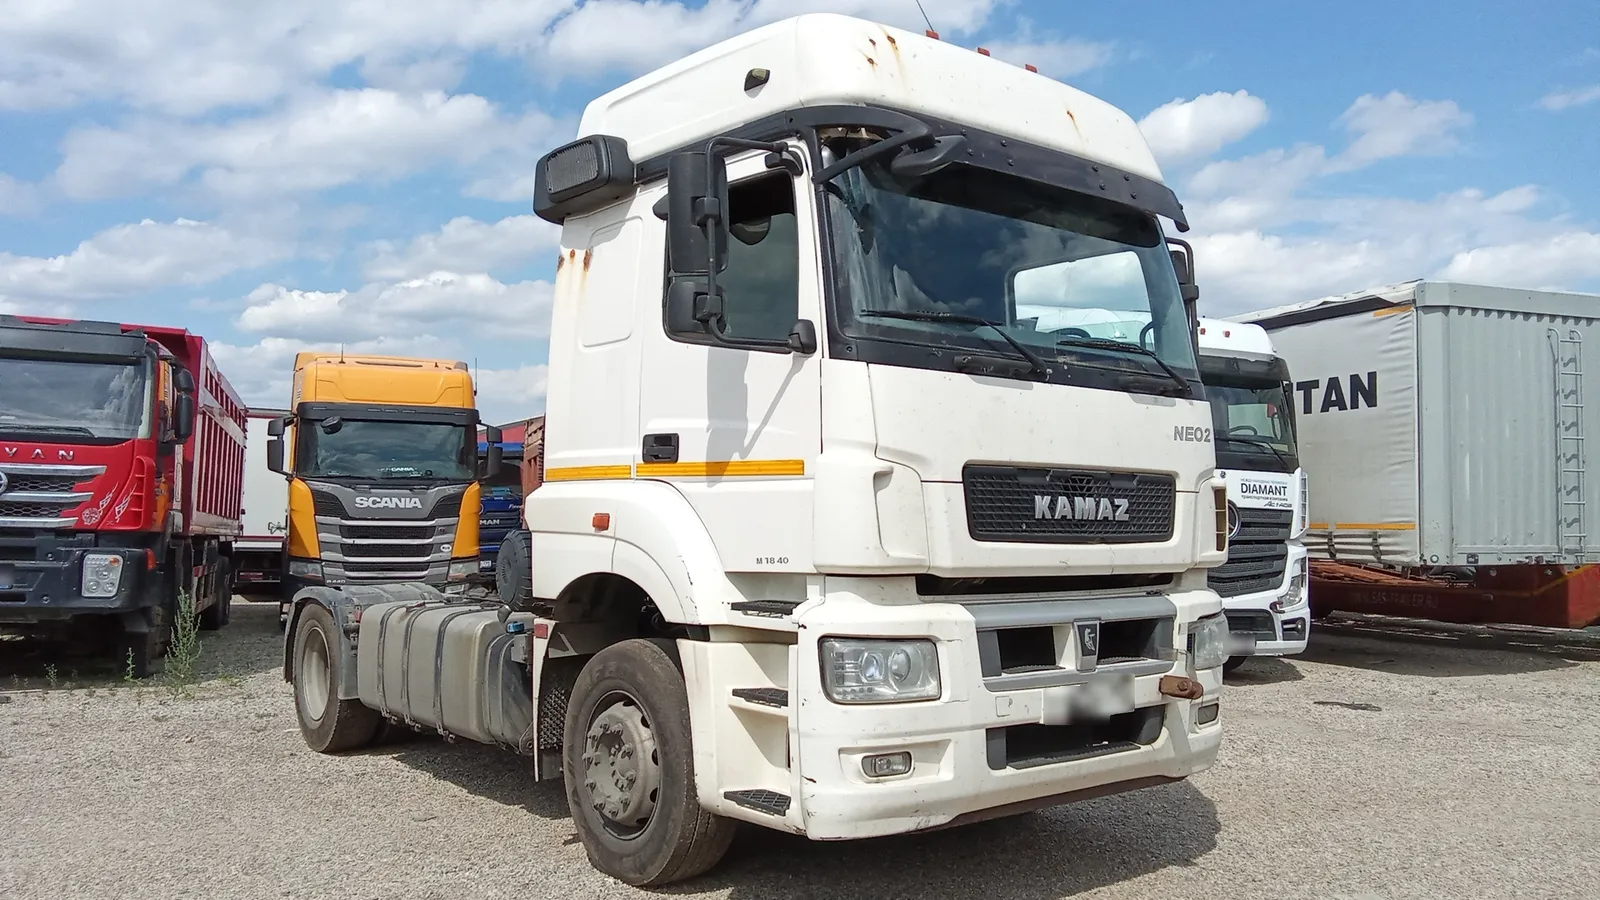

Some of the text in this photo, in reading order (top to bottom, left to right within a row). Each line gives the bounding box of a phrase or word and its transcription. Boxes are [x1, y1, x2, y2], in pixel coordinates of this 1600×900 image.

[1291, 371, 1377, 414] TAN
[1241, 482, 1287, 496] DIAMANT
[354, 496, 422, 509] SCANIA
[1034, 495, 1130, 521] KAMAZ
